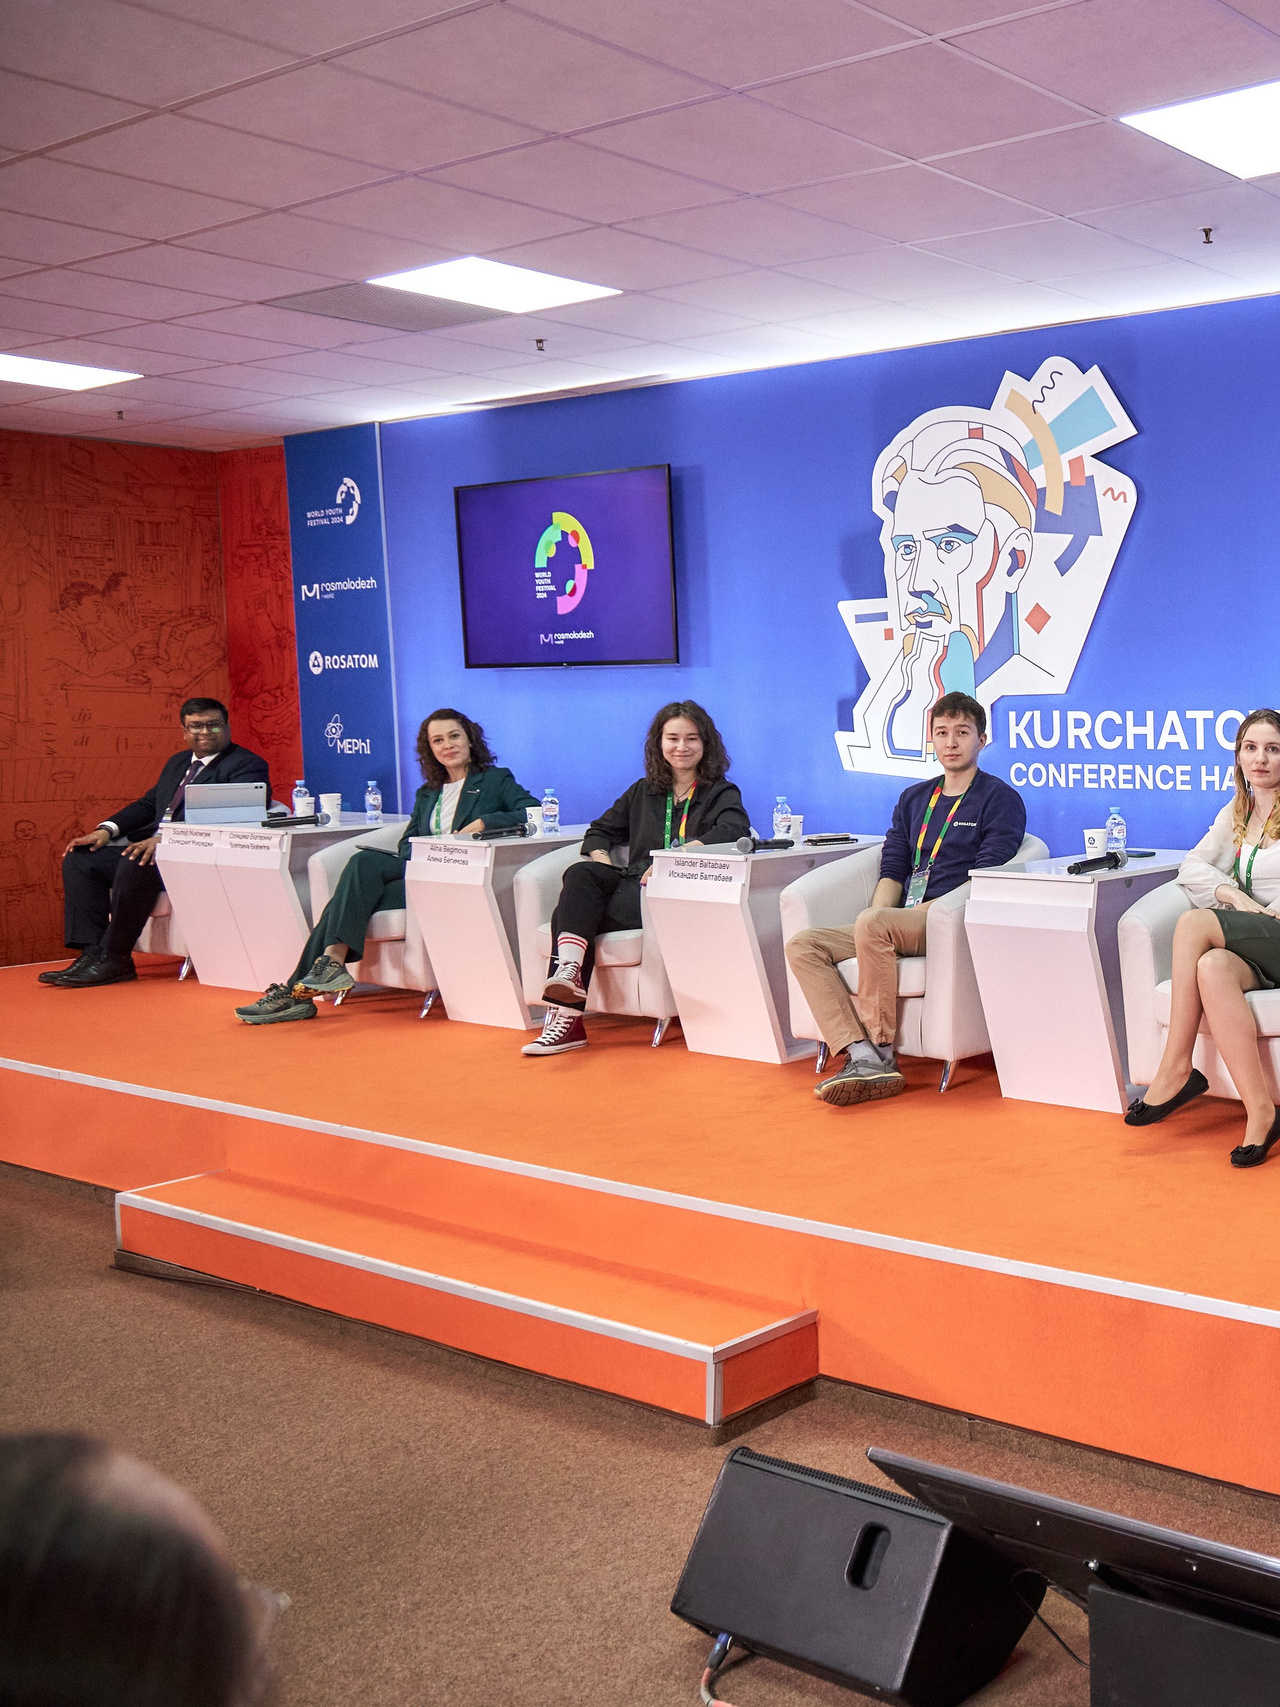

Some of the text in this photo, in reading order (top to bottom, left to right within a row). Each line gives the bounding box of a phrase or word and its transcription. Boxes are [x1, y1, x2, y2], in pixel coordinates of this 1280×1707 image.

[320, 576, 377, 592] rosmolodezh
[553, 630, 595, 640] rosmolodezh
[324, 654, 379, 669] ROSATOM
[336, 738, 371, 754] MEPhI
[1009, 762, 1192, 791] CONFERENCE
[430, 844, 468, 855] Alina Begimova
[427, 855, 469, 866] Алина Бегимова
[699, 859, 730, 870] Baltabaev
[668, 869, 733, 883] Искандер Балтабаев
